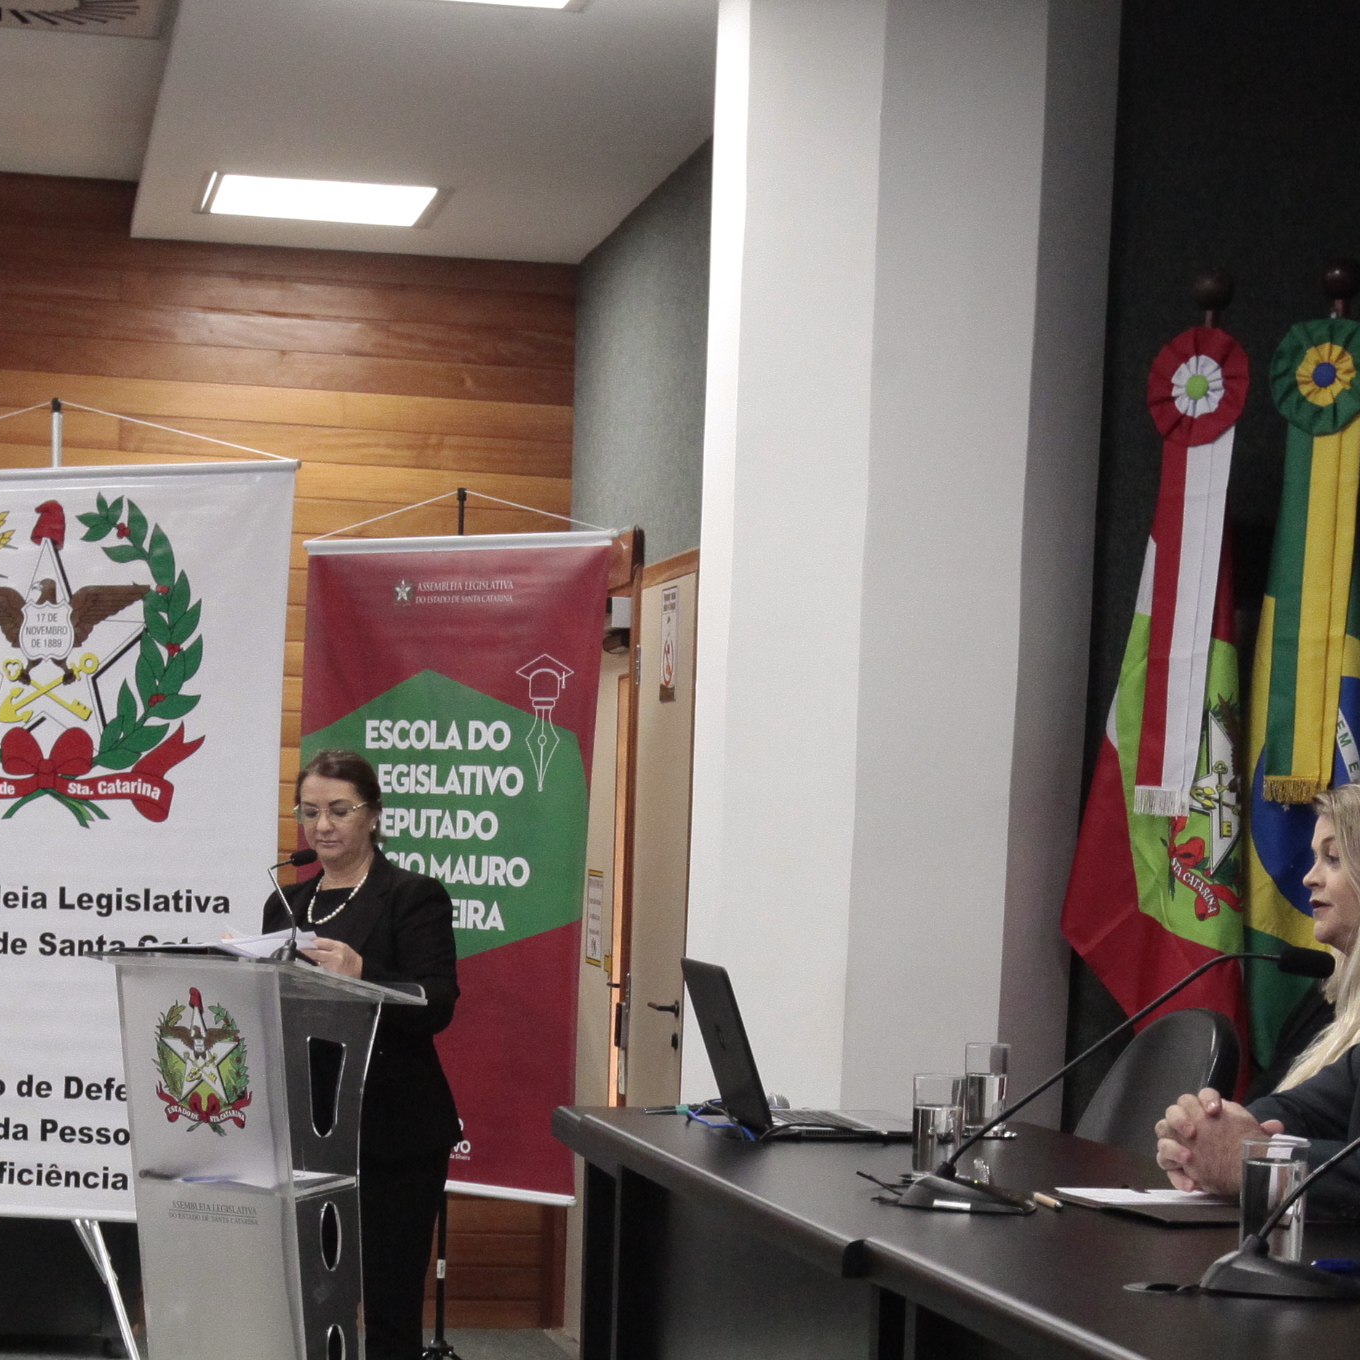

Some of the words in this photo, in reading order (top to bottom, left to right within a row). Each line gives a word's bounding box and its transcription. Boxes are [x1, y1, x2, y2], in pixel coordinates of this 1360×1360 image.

[417, 581, 462, 592] ASSEMBLEIA
[464, 580, 514, 591] LEGISLATIVA
[25, 625, 68, 636] NOVEMBRO
[36, 613, 46, 623] 17
[47, 613, 58, 623] DE
[31, 638, 41, 648] DE
[44, 638, 62, 648] 1889
[365, 719, 463, 750] ESCOLA
[468, 720, 512, 751] DO
[67, 781, 94, 796] Sta.
[97, 778, 162, 800] Catarina
[377, 763, 524, 797] EGISLATIVO
[379, 807, 499, 841] EPUTADO
[429, 854, 531, 888] MAURO
[59, 886, 230, 917] Legislativa
[1182, 872, 1217, 914] CATARINA
[450, 898, 506, 931] EIRA
[16, 1074, 53, 1099] de
[63, 1075, 128, 1102] Defe
[40, 1118, 131, 1146] Pesso
[172, 1200, 211, 1212] SSEMBLEIA
